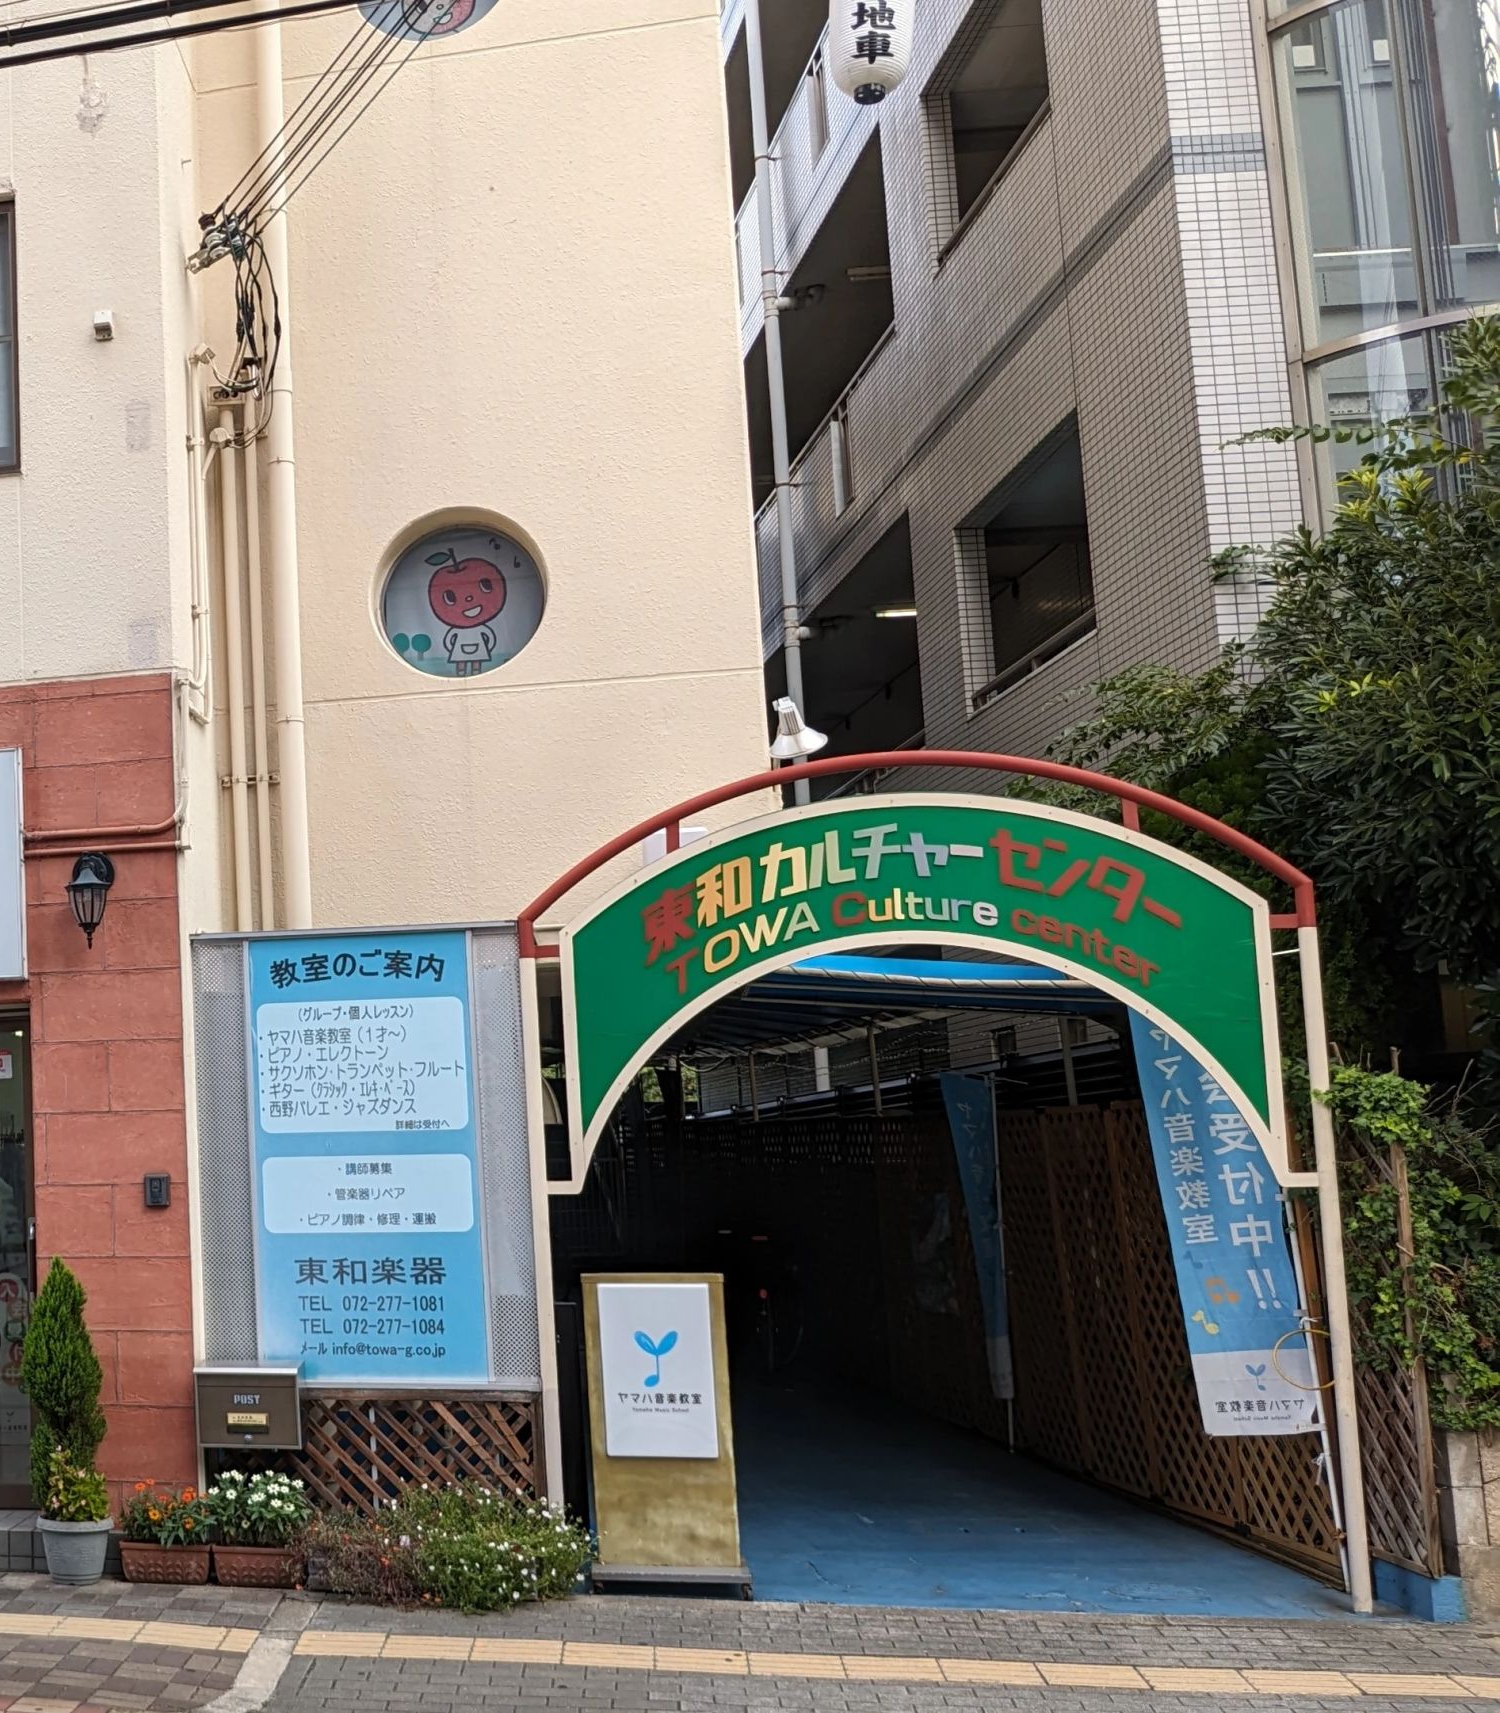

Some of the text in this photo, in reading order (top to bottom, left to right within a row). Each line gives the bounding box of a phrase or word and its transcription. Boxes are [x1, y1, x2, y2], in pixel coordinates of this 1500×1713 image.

[850, 0, 897, 65] 地車
[642, 822, 1184, 967] 東和カルチャーセンター
[664, 886, 1161, 996] TOWA Culture center
[269, 948, 446, 989] 教室のご案内
[395, 1119, 450, 1131] 詳細は受付へ
[294, 1256, 447, 1286] 東和楽器
[298, 1295, 445, 1313] TEL 072-277-1081
[300, 1318, 445, 1335] TEL 072-277-1084
[332, 1342, 446, 1359] info@towa-g.co.jp
[233, 1394, 261, 1404] POST
[617, 1391, 703, 1406] ヤマハ音楽教室
